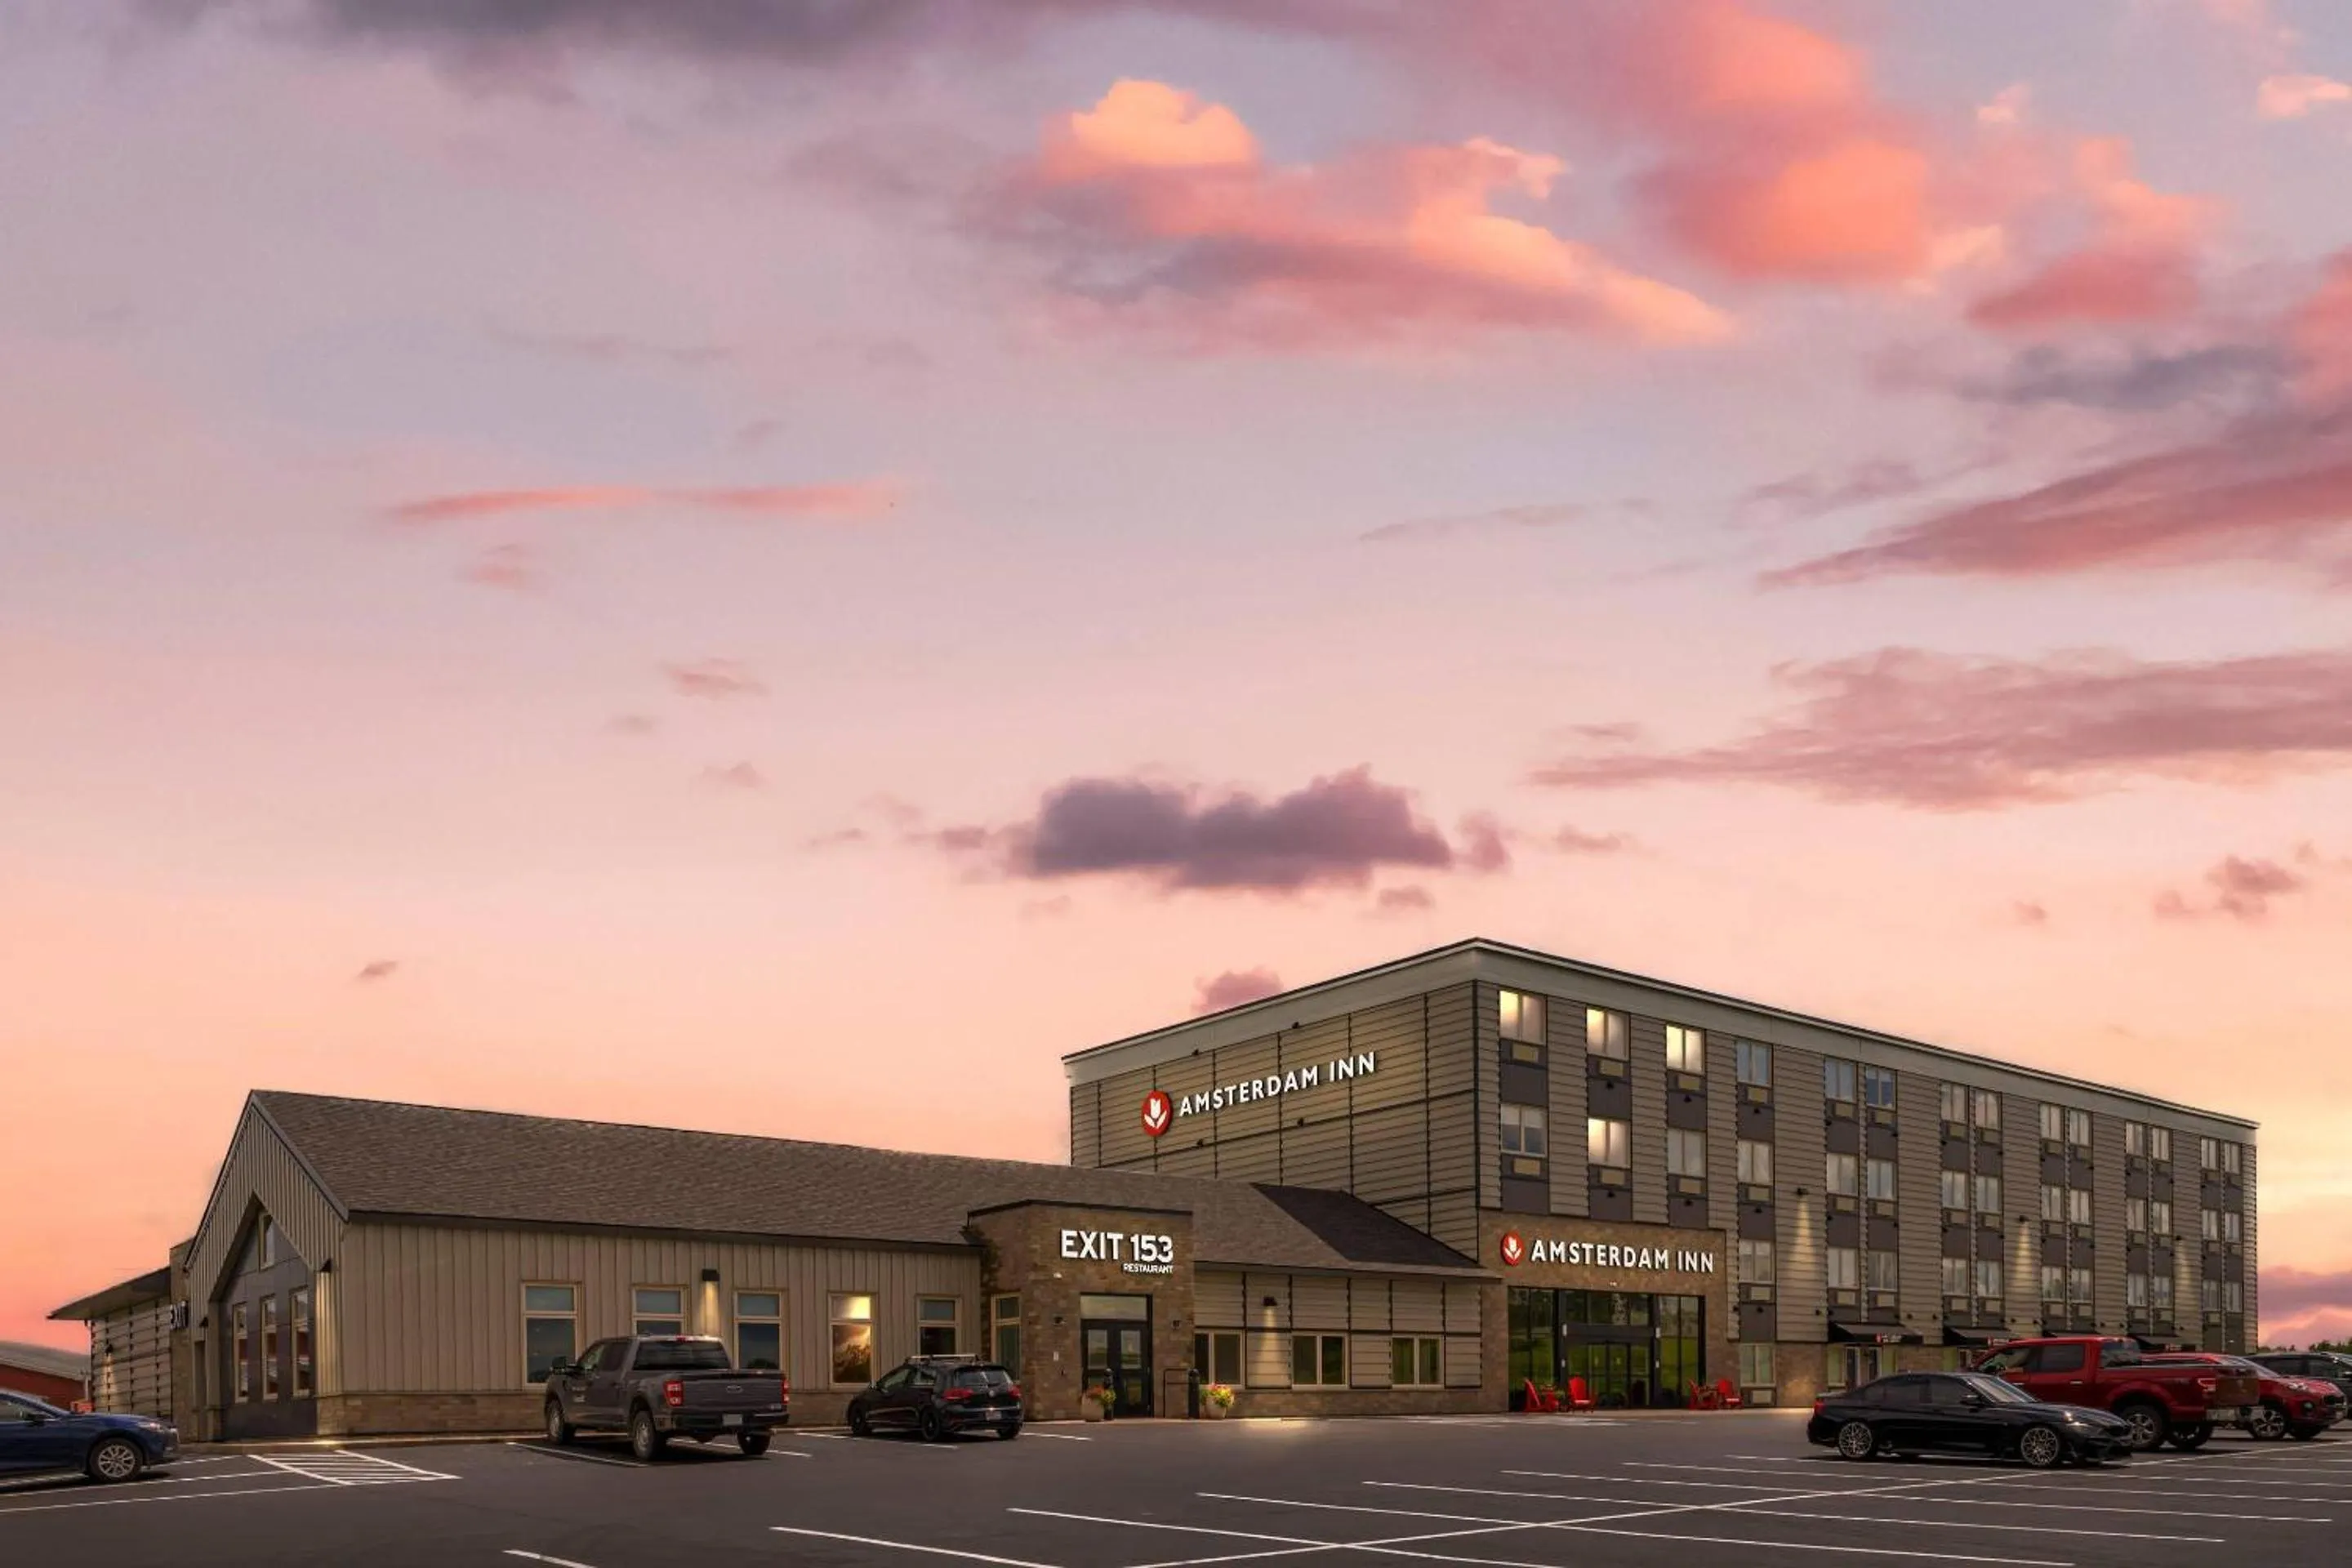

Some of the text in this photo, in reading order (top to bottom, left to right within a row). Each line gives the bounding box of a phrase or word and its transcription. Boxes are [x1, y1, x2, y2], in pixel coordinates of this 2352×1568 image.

[1178, 1051, 1375, 1117] AMSTERDAM INN
[1061, 1229, 1174, 1263] EXIT 153
[1531, 1239, 1713, 1273] AMSTERDAM INN
[1123, 1263, 1174, 1274] RESTAURANT
